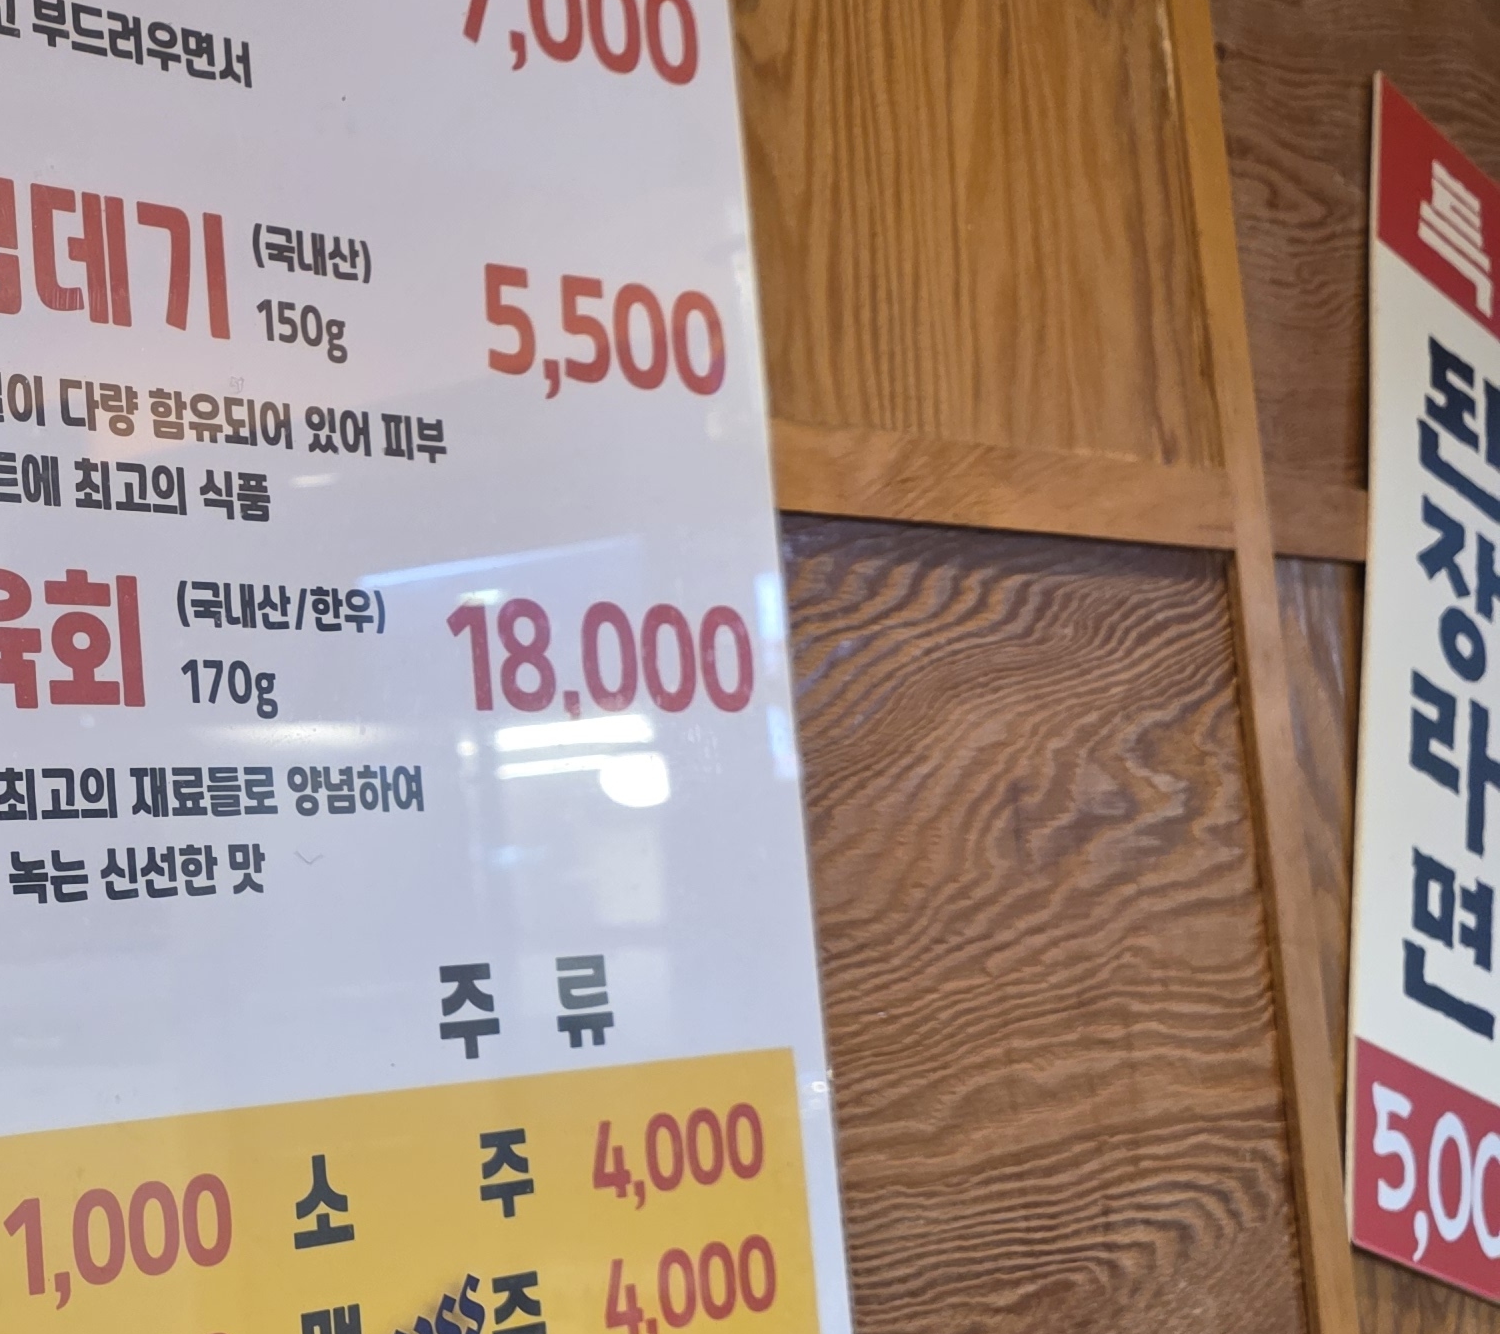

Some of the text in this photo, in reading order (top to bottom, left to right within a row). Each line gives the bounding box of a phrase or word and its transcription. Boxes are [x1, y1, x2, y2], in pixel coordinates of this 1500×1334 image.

[251, 222, 373, 284] (국내산)
[255, 298, 348, 363] 150g
[483, 262, 726, 399] 5,500
[58, 378, 139, 436] 다량
[148, 388, 293, 451] 함유되어
[304, 407, 373, 458] 있어
[381, 412, 448, 465] 피부
[73, 457, 187, 517] 최고의
[199, 469, 271, 523] 식품
[176, 579, 386, 634] (국내산/한우)
[180, 660, 279, 720] 170g
[446, 596, 754, 719] 18,000
[130, 765, 279, 819] 재료들로
[287, 764, 425, 818] 양념하여
[9, 848, 89, 906] 녹는
[100, 844, 218, 901] 신선한
[227, 842, 266, 896] 맛
[592, 1101, 764, 1210] 4,000
[3, 1172, 233, 1313] 1,000
